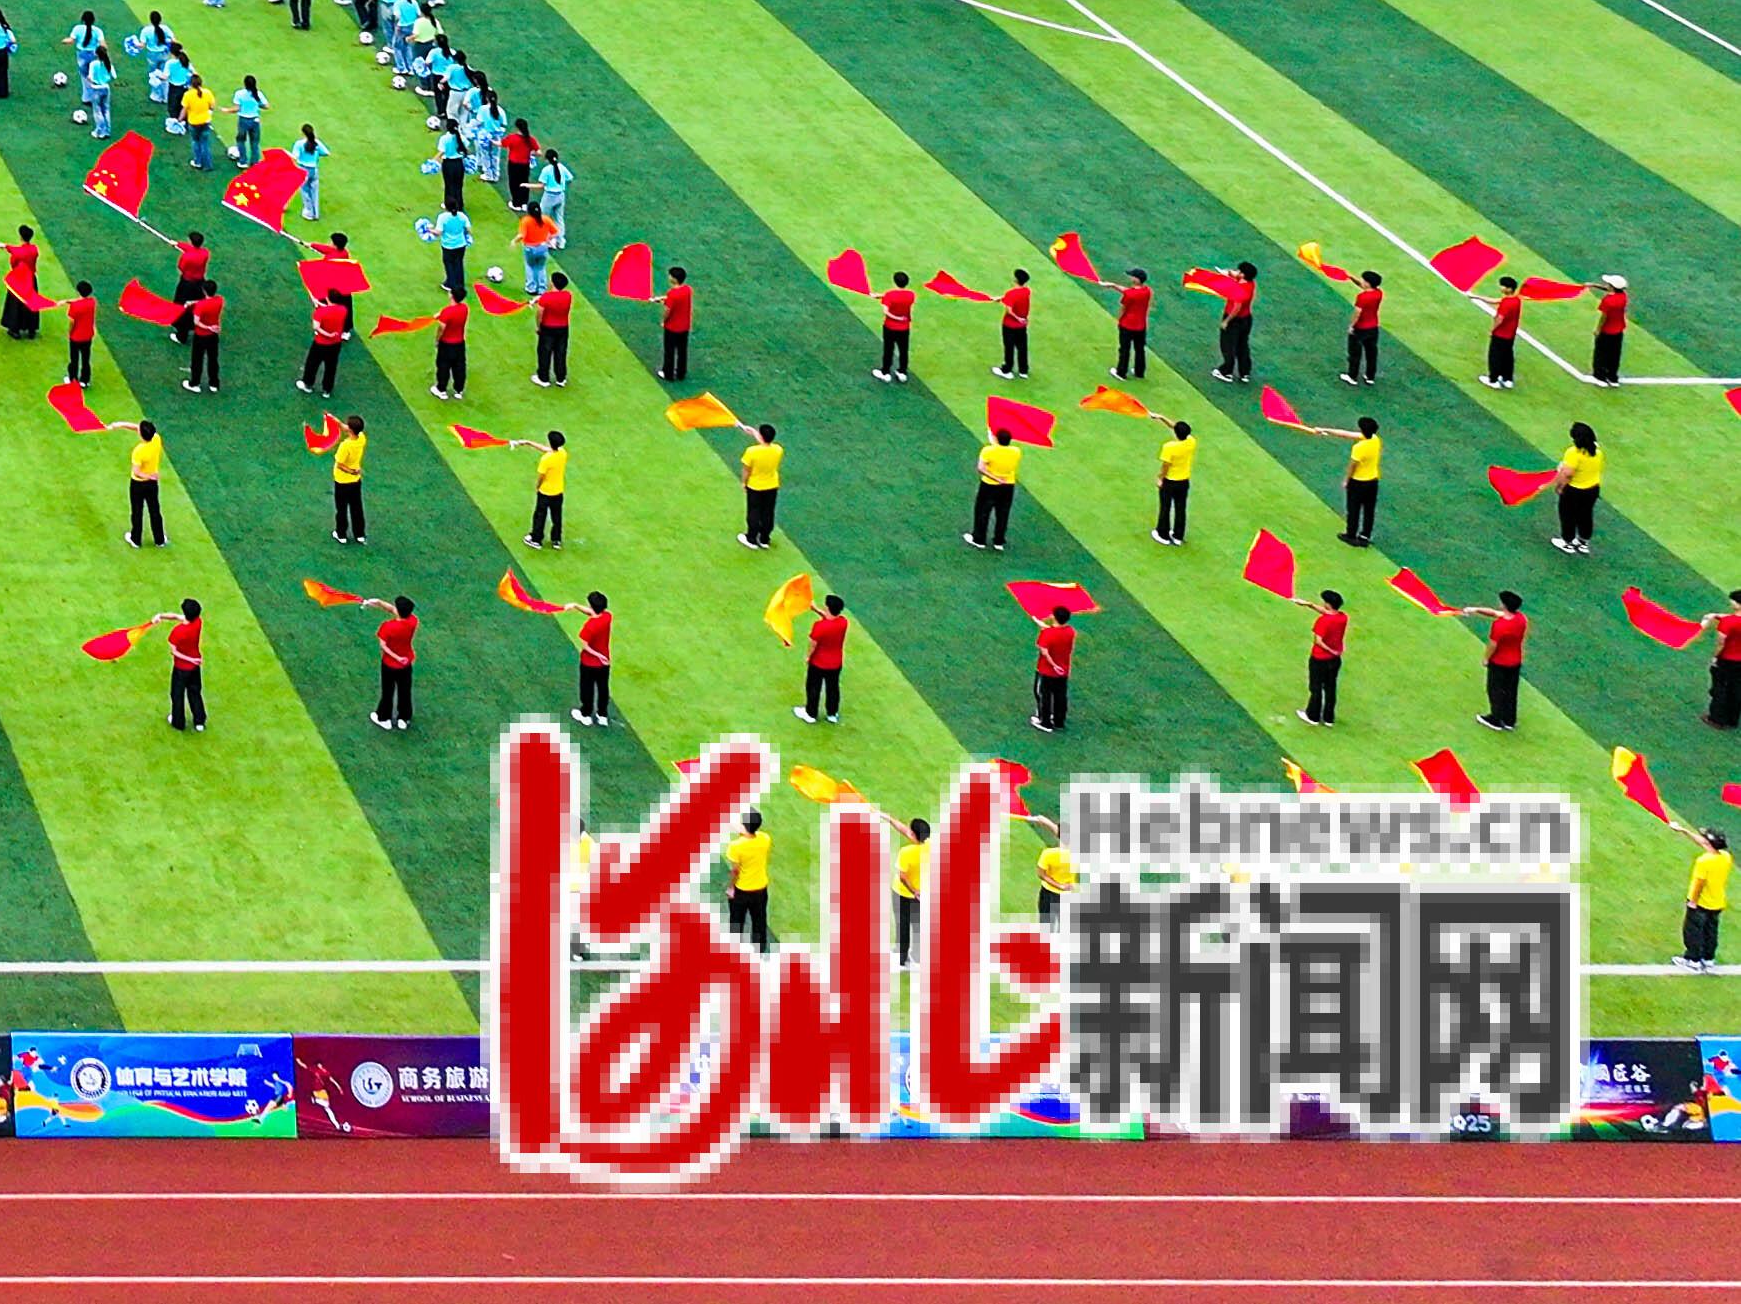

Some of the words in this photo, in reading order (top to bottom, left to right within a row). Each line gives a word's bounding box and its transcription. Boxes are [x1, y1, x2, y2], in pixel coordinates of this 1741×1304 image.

[115, 1066, 248, 1088] 体育与艺术学院
